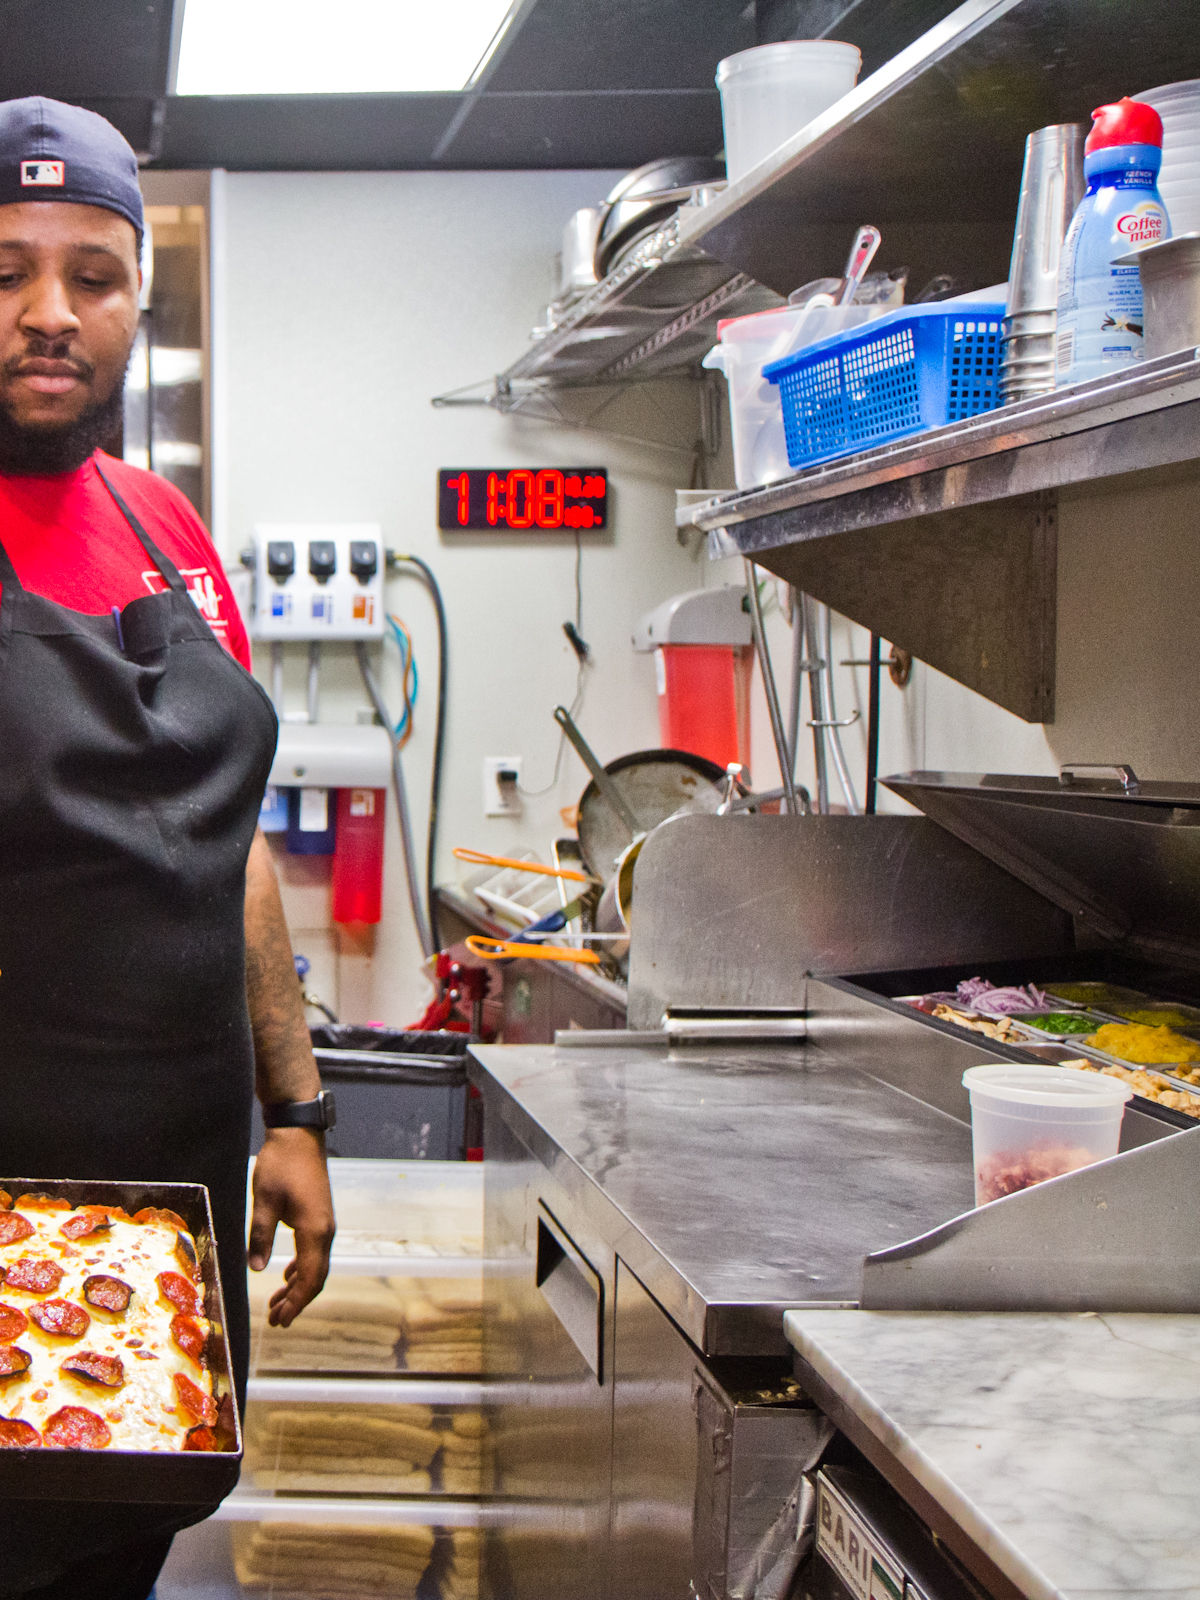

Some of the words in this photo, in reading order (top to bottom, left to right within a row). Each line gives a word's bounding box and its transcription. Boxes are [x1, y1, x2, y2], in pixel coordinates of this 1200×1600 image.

[1123, 177, 1153, 185] VANILLA
[1117, 214, 1162, 234] Coffee
[1130, 229, 1161, 243] mate
[447, 469, 565, 529] 11:08
[821, 1494, 868, 1582] BARI
